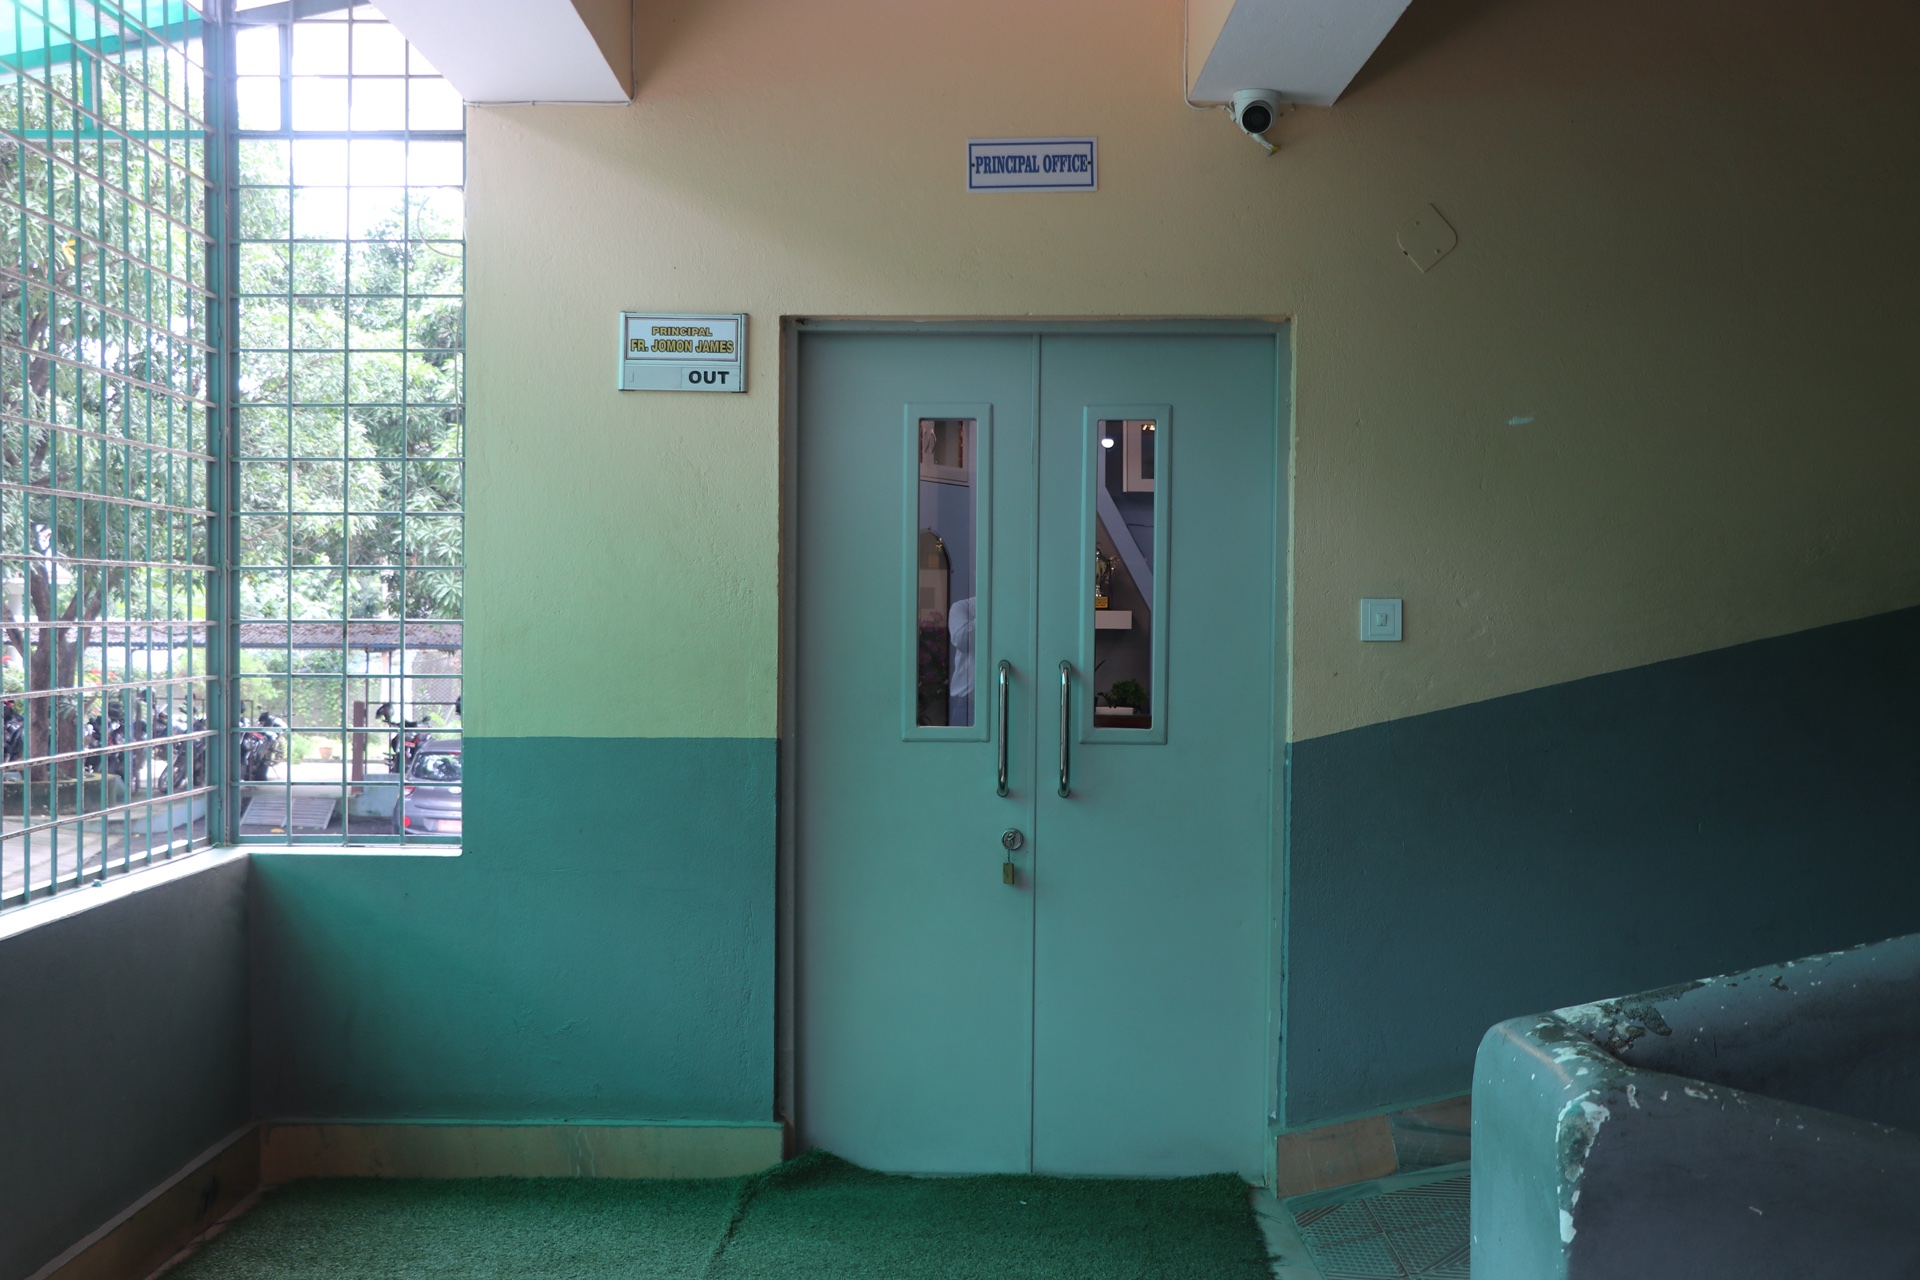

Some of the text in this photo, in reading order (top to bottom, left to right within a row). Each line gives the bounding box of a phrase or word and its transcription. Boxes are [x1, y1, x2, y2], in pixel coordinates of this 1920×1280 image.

[975, 154, 1088, 174] PRINCIPAL OFFICE
[652, 326, 713, 337] PRINCIPAL
[630, 339, 734, 353] FR. JOMON JAMES
[688, 370, 729, 385] OUT
